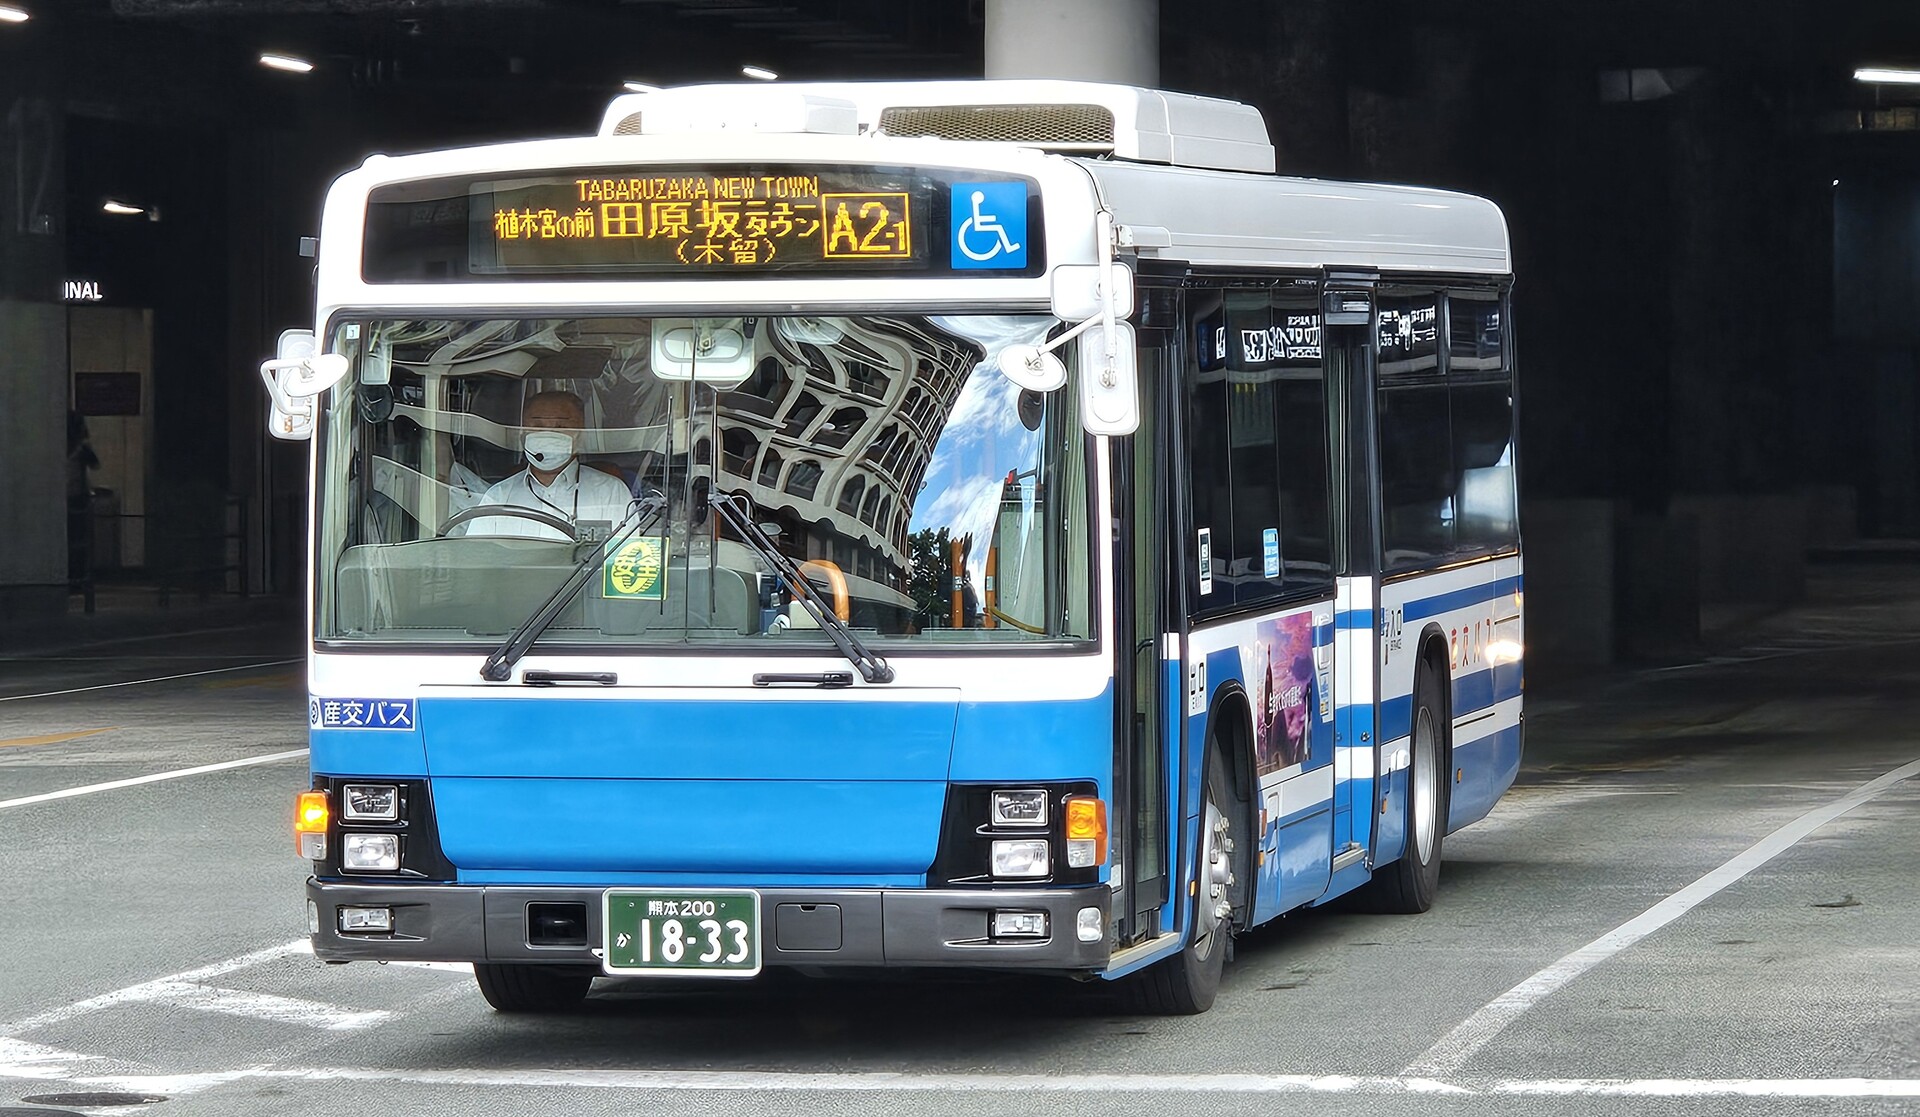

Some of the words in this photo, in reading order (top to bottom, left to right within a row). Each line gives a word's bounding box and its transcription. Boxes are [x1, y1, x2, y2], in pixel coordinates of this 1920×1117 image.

[575, 177, 708, 201] TABARUZAKA
[713, 177, 755, 199] NEW
[761, 176, 819, 199] TOWN
[324, 701, 411, 725] 産交バス
[641, 919, 749, 963] 18-33
